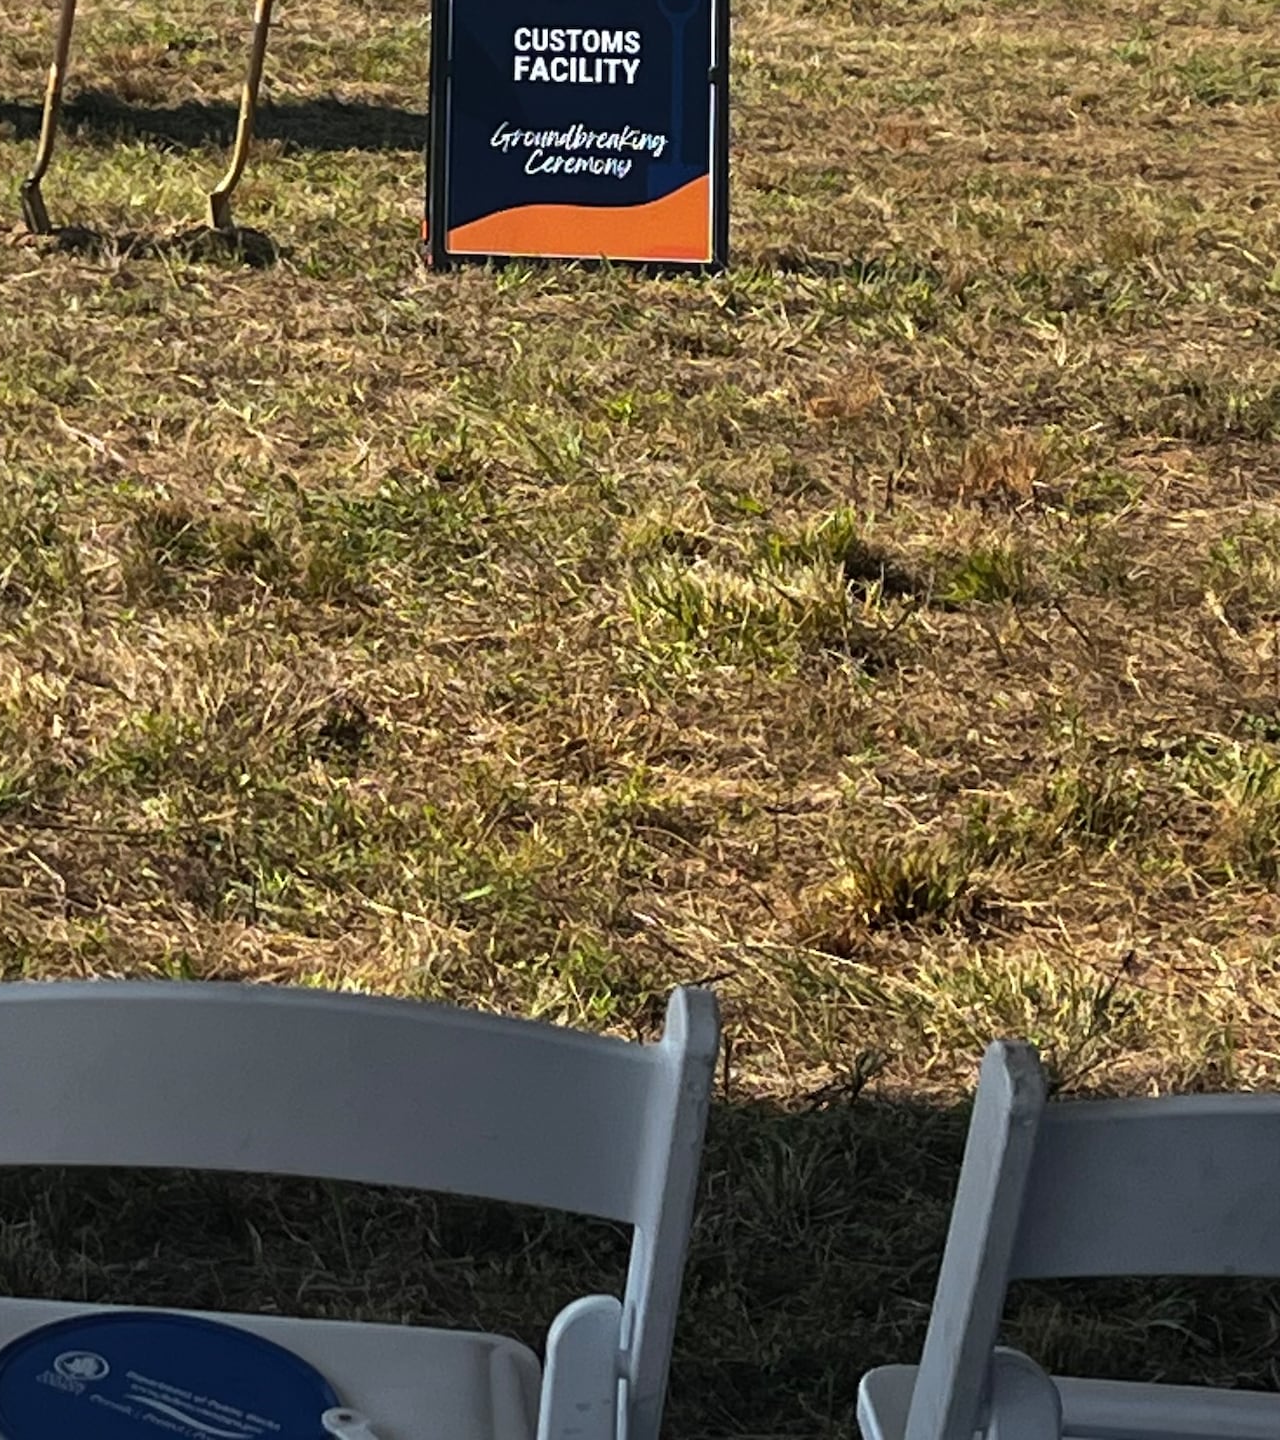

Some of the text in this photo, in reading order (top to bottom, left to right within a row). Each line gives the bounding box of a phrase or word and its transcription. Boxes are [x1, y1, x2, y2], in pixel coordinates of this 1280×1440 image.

[514, 28, 640, 54] CUSTOMS
[514, 56, 640, 84] FACILITY
[490, 121, 668, 158] Groundbreaking
[524, 148, 633, 179] Ceremony
